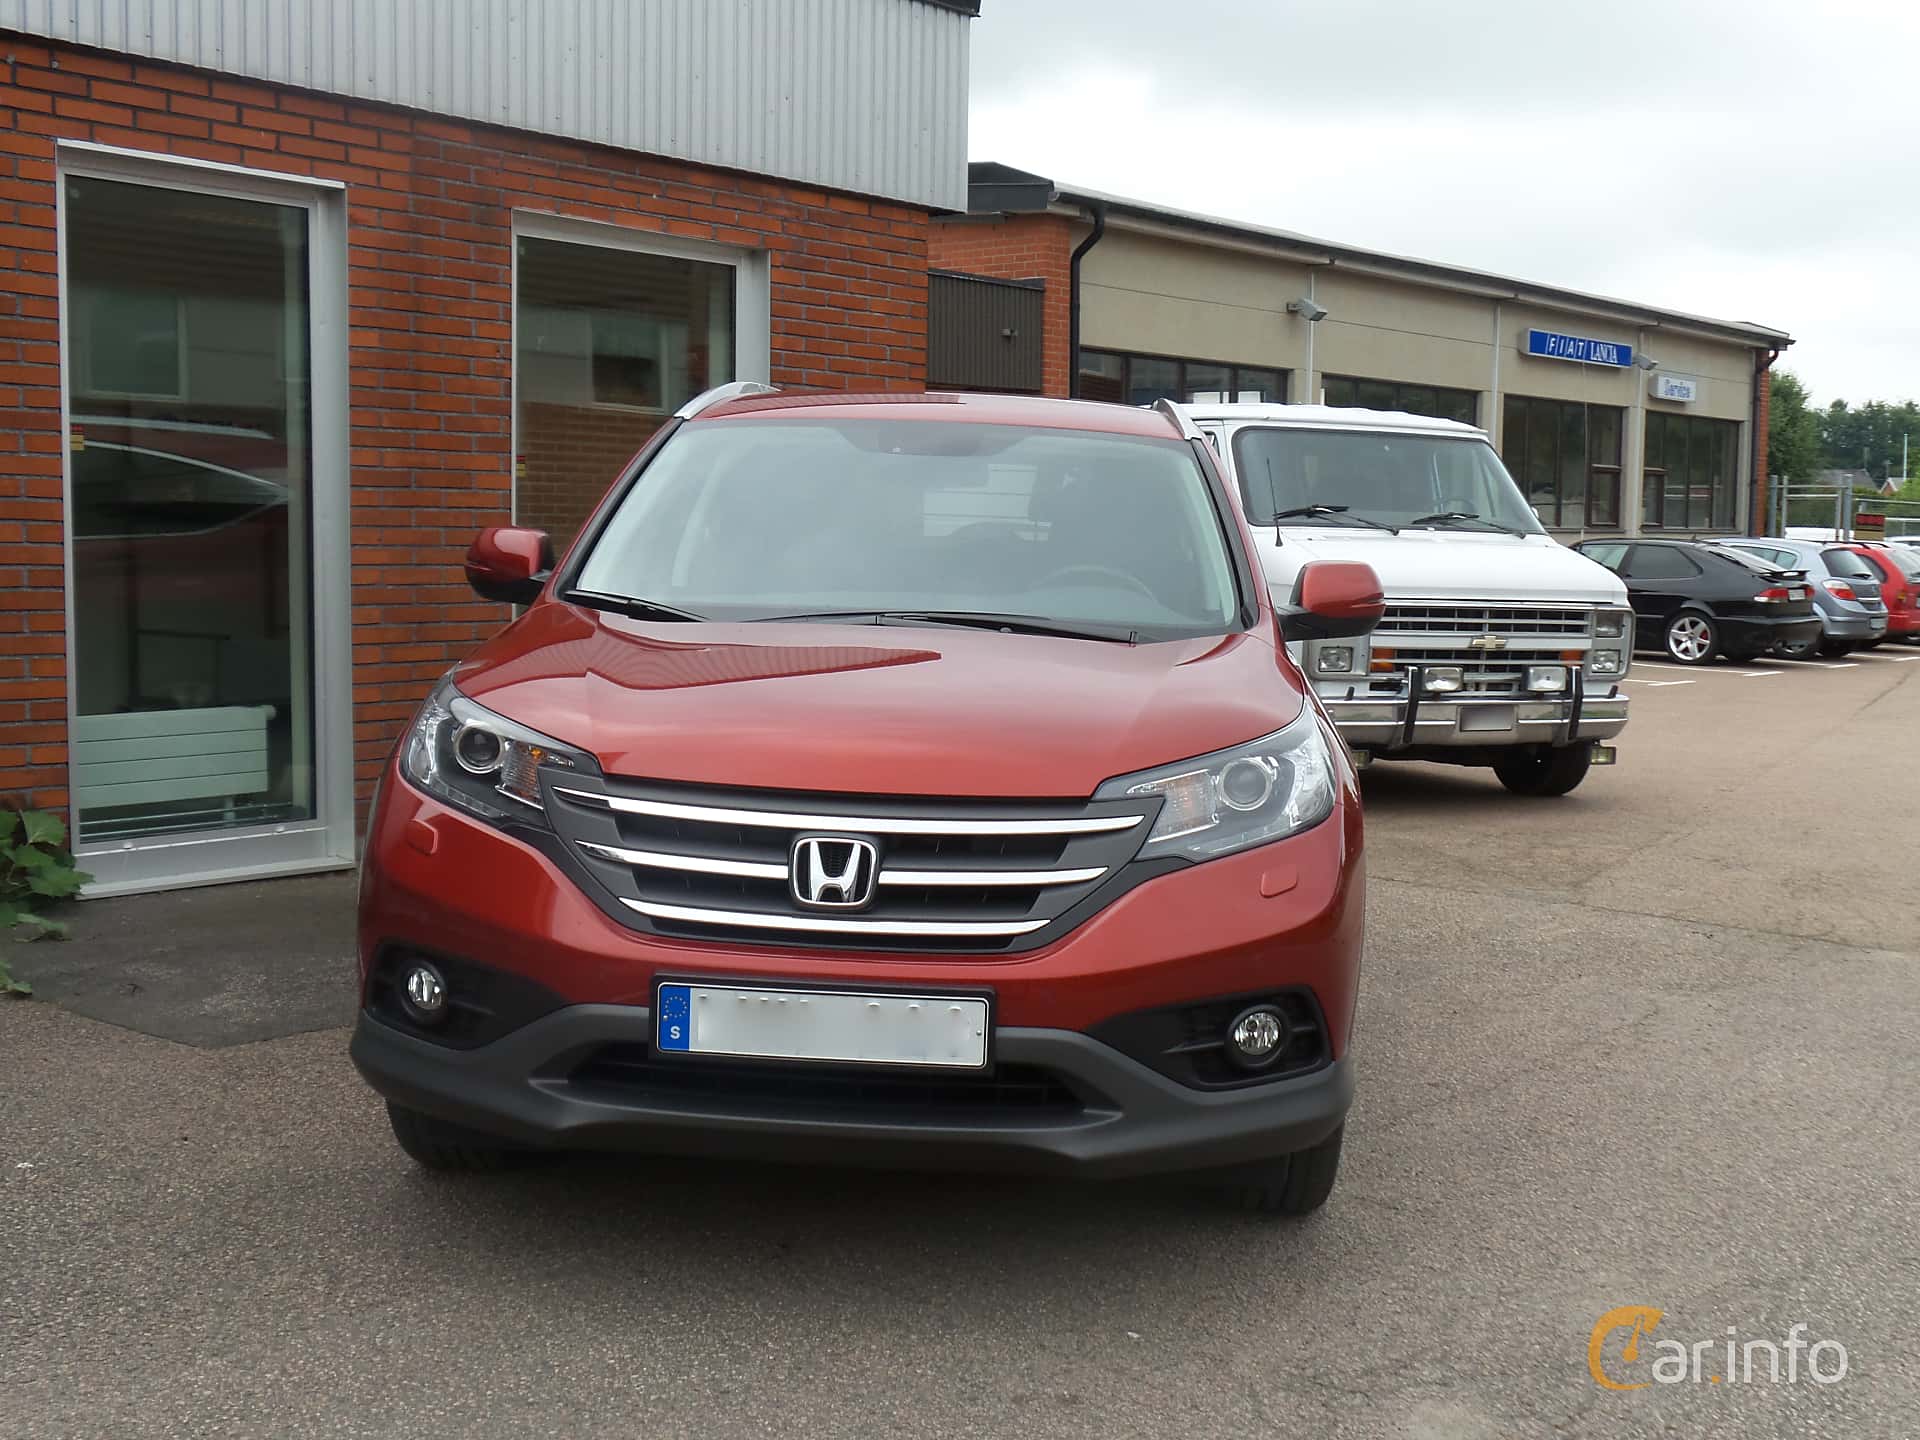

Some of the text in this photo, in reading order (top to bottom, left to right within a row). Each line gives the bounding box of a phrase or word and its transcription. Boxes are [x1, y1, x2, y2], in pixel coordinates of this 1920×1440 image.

[1548, 337, 1618, 364] FIAT LANCIA
[670, 1025, 681, 1040] S
